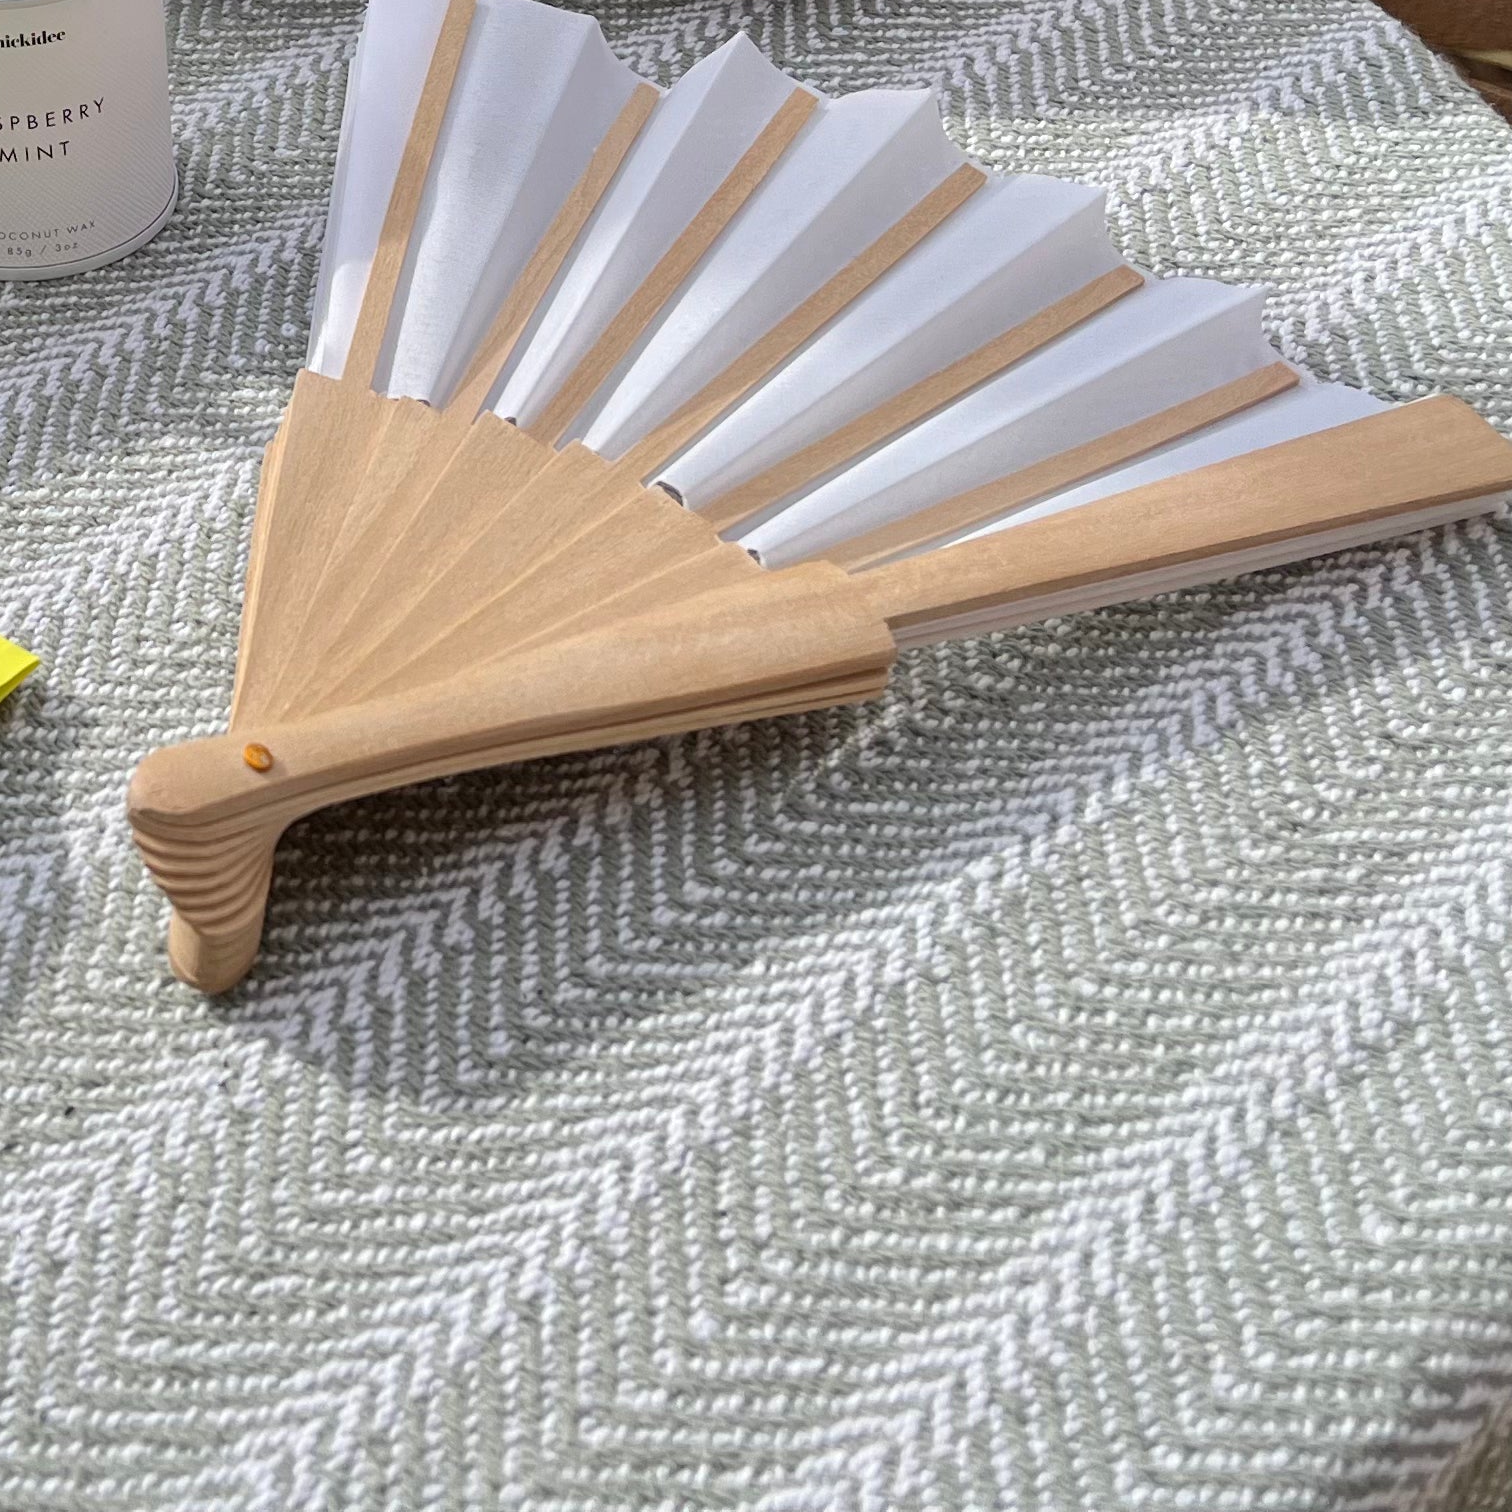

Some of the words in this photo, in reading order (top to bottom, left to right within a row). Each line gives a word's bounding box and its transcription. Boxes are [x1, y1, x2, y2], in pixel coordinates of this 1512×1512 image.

[0, 140, 70, 162] MINT
[66, 219, 96, 234] WAX
[7, 247, 32, 258] 85g
[55, 242, 78, 253] 3oz
